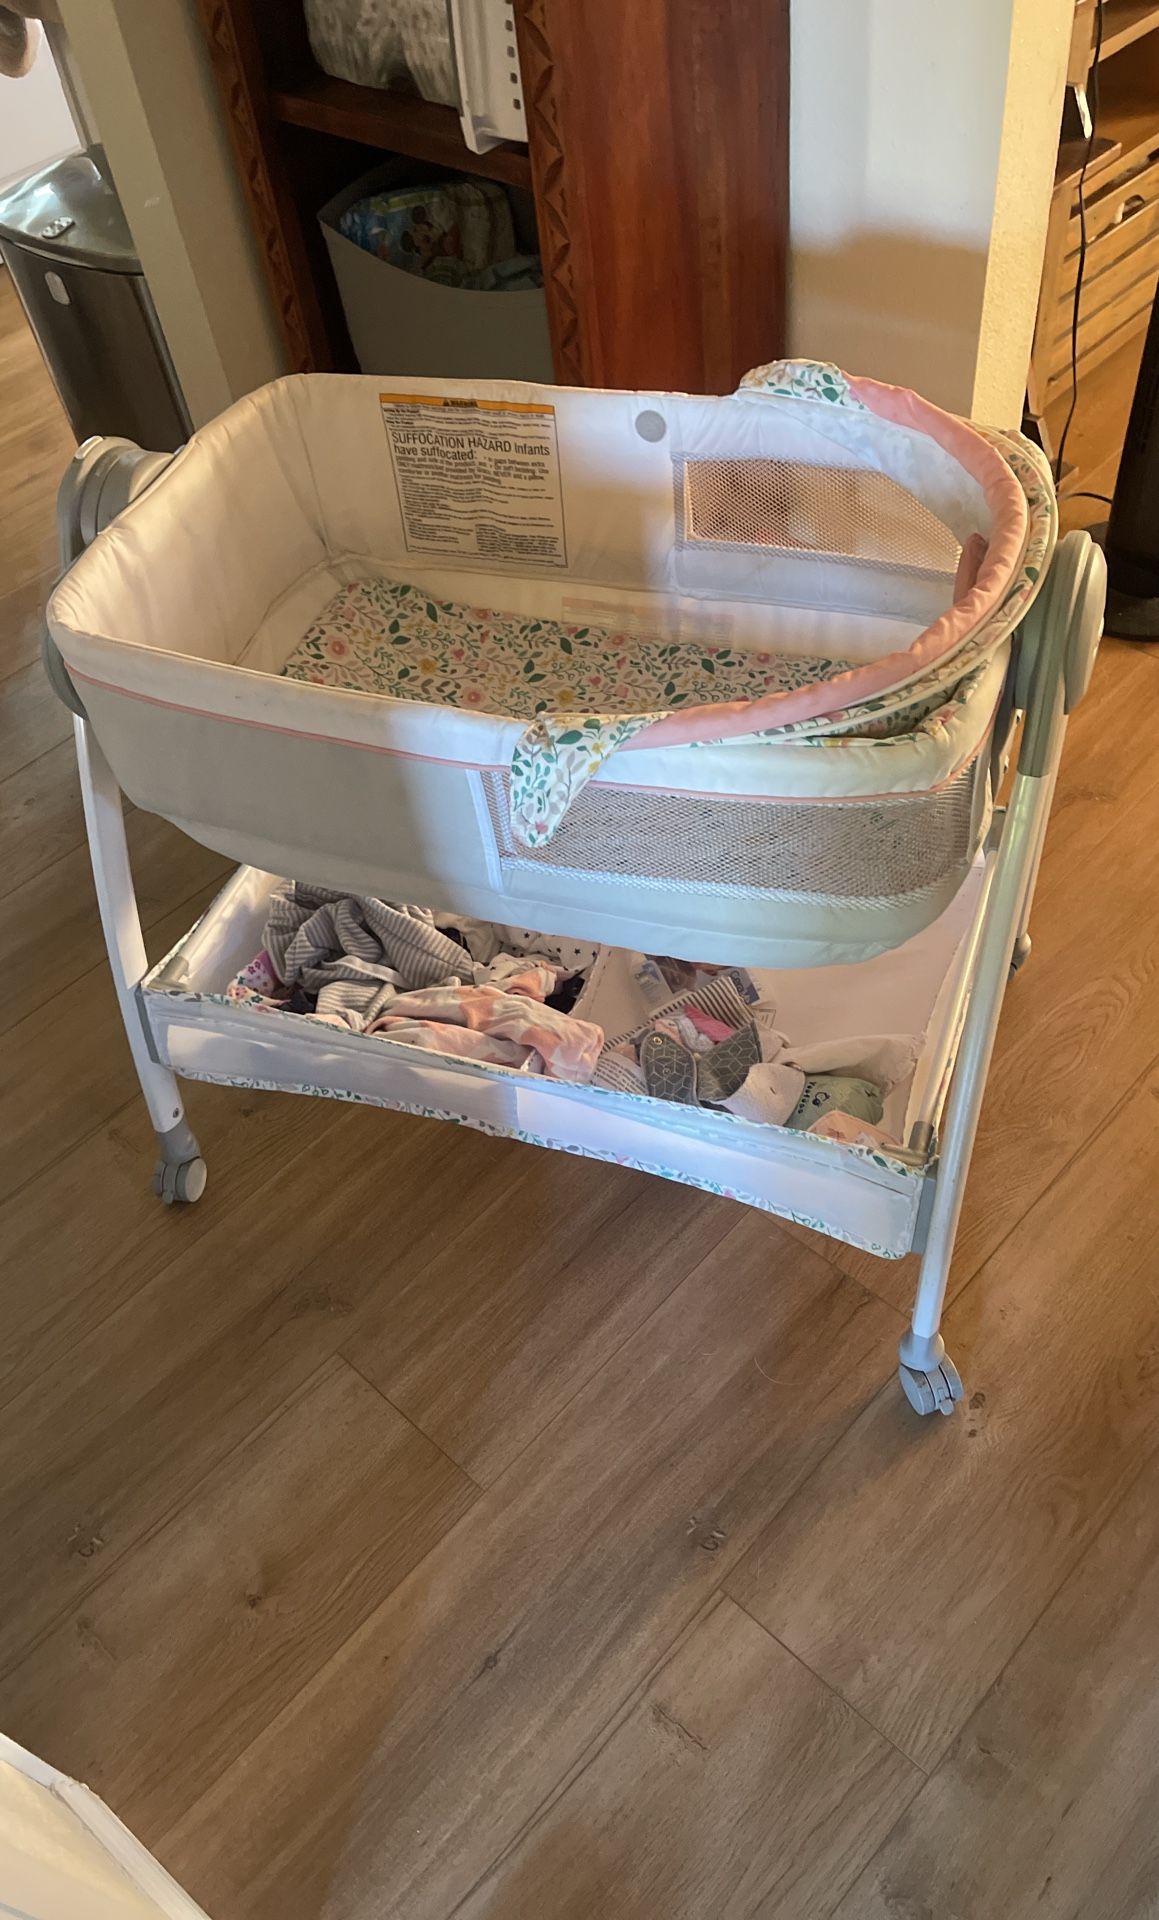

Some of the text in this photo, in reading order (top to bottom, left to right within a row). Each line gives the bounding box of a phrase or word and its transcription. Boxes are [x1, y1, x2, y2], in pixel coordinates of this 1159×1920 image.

[392, 431, 464, 449] SUFFOCATION
[468, 437, 512, 453] HAZARD
[514, 442, 551, 456] Infants
[394, 443, 418, 456] have
[420, 446, 478, 461] suffocated:
